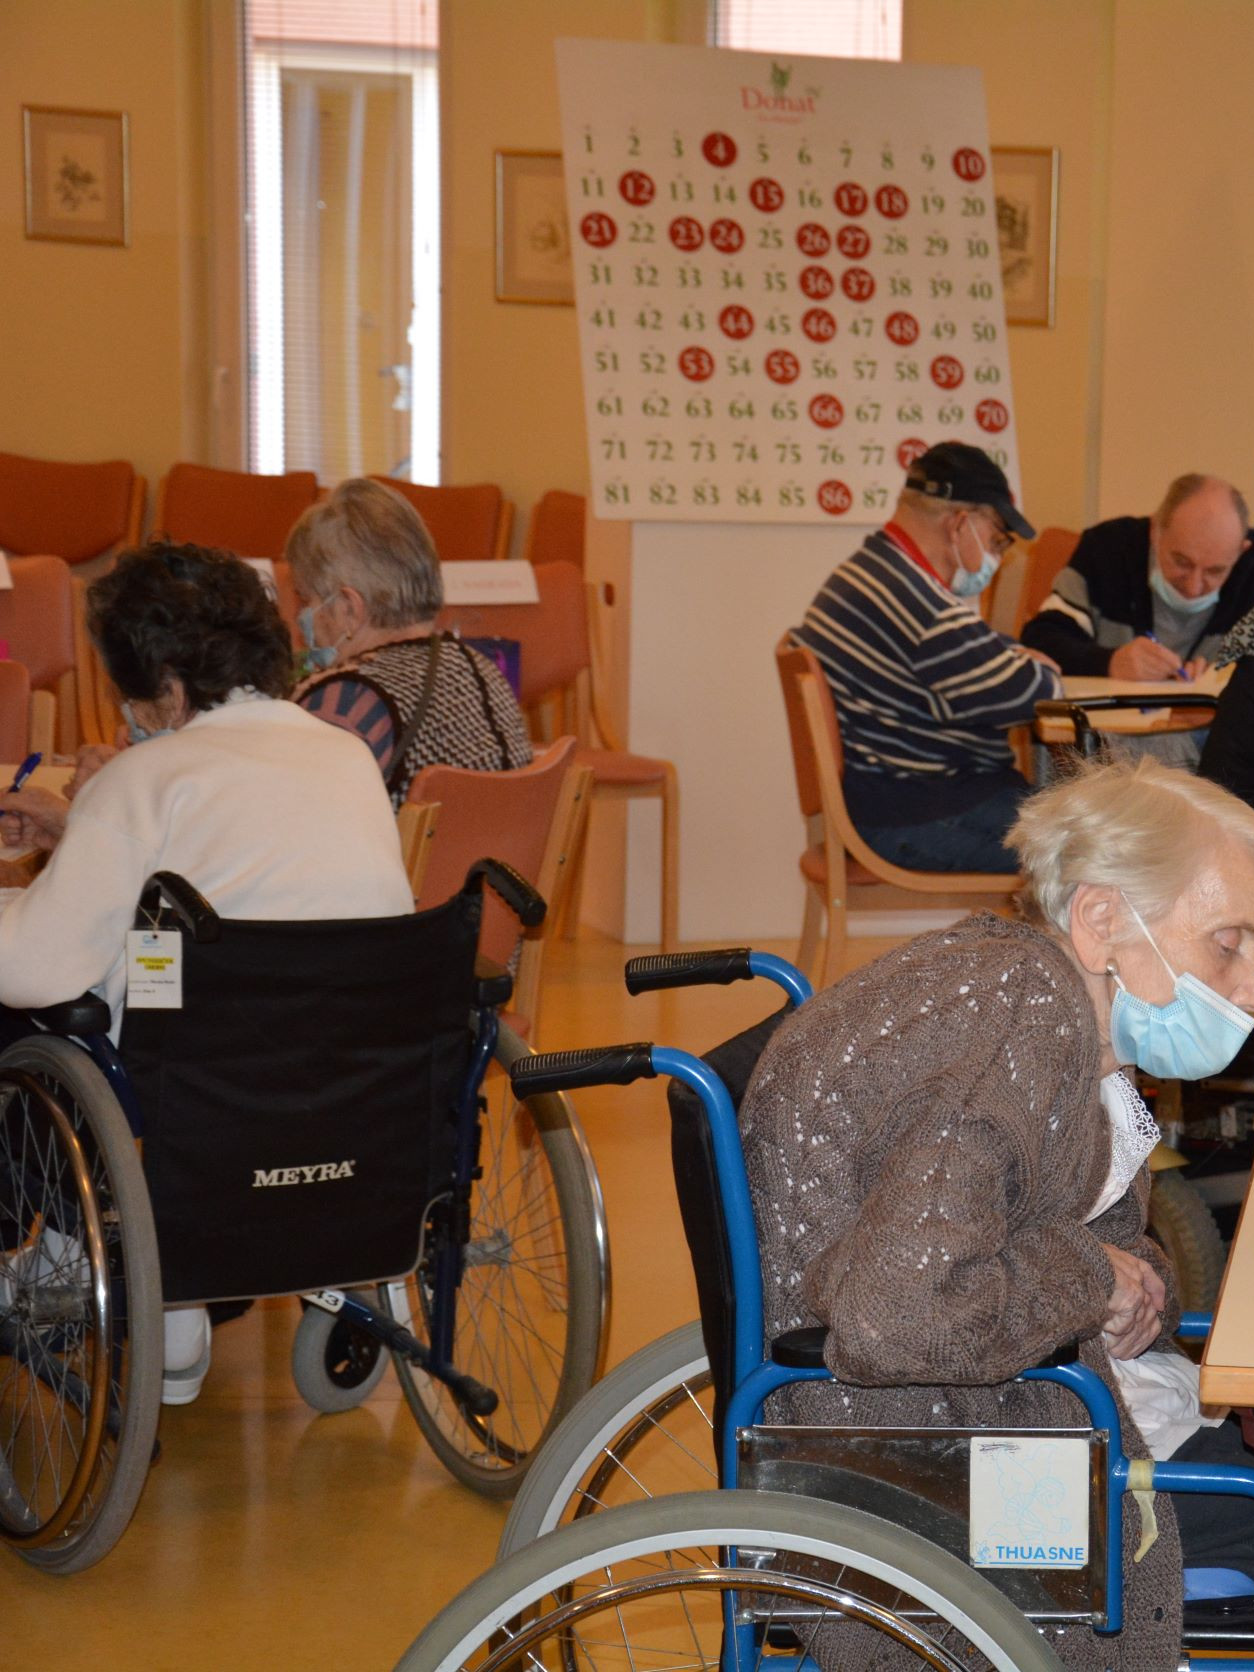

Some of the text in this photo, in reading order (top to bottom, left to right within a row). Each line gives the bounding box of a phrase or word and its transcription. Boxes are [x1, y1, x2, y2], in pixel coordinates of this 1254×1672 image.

[584, 133, 983, 175] 1 2 3 4 5 6 7 8 9 10
[581, 176, 987, 218] 11 12 13 14 15 16 17 18 19 20
[586, 219, 990, 259] 21 22 23 24 25 26 27 28 29 30
[590, 263, 993, 301] 31 32 33 34 35 36 37 38 39 40
[590, 308, 997, 343] 41 42 43 44 45 46 47 48 49 50
[595, 351, 1001, 384] 51 52 53 54 55 56 57 58 59 60
[596, 396, 1006, 426] 61 62 63 64 65 66 67 68 69 70
[601, 438, 627, 460] 71
[645, 439, 674, 462] 72
[689, 440, 717, 463] 73
[732, 441, 760, 463] 74
[775, 442, 802, 465] 75
[817, 443, 845, 465] 76
[858, 444, 886, 466] 77
[604, 483, 889, 508] 81 82 83 84 85 86 87
[252, 1160, 355, 1187] MEYRA
[995, 1545, 1085, 1561] THUASNE
